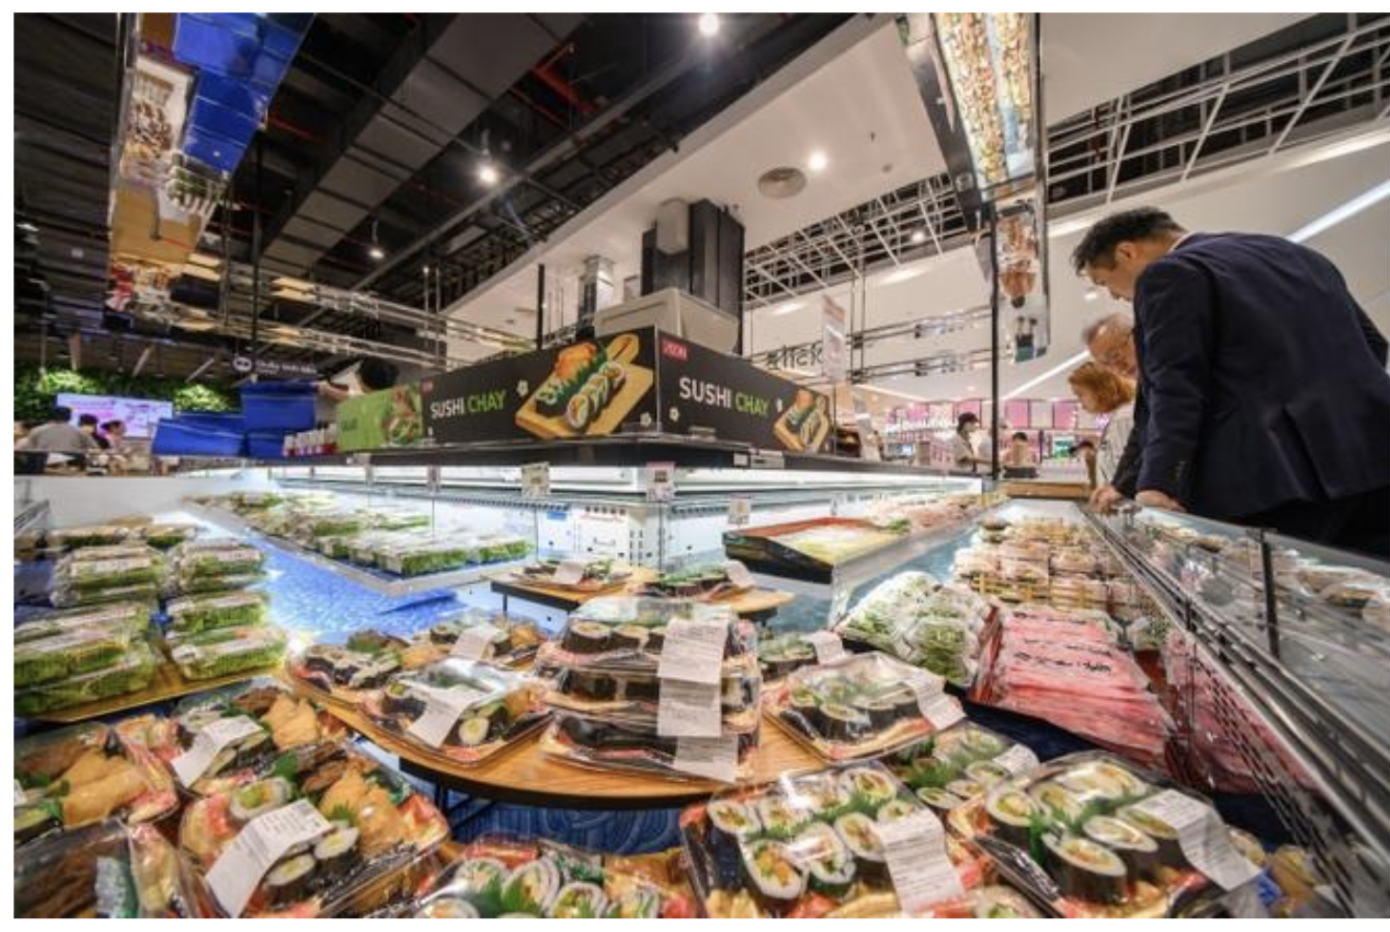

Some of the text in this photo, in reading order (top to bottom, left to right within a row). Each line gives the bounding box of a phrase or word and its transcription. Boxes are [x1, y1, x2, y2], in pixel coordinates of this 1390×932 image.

[430, 389, 506, 419] SUSHI CHAY
[679, 375, 769, 416] SUSHI CHAY
